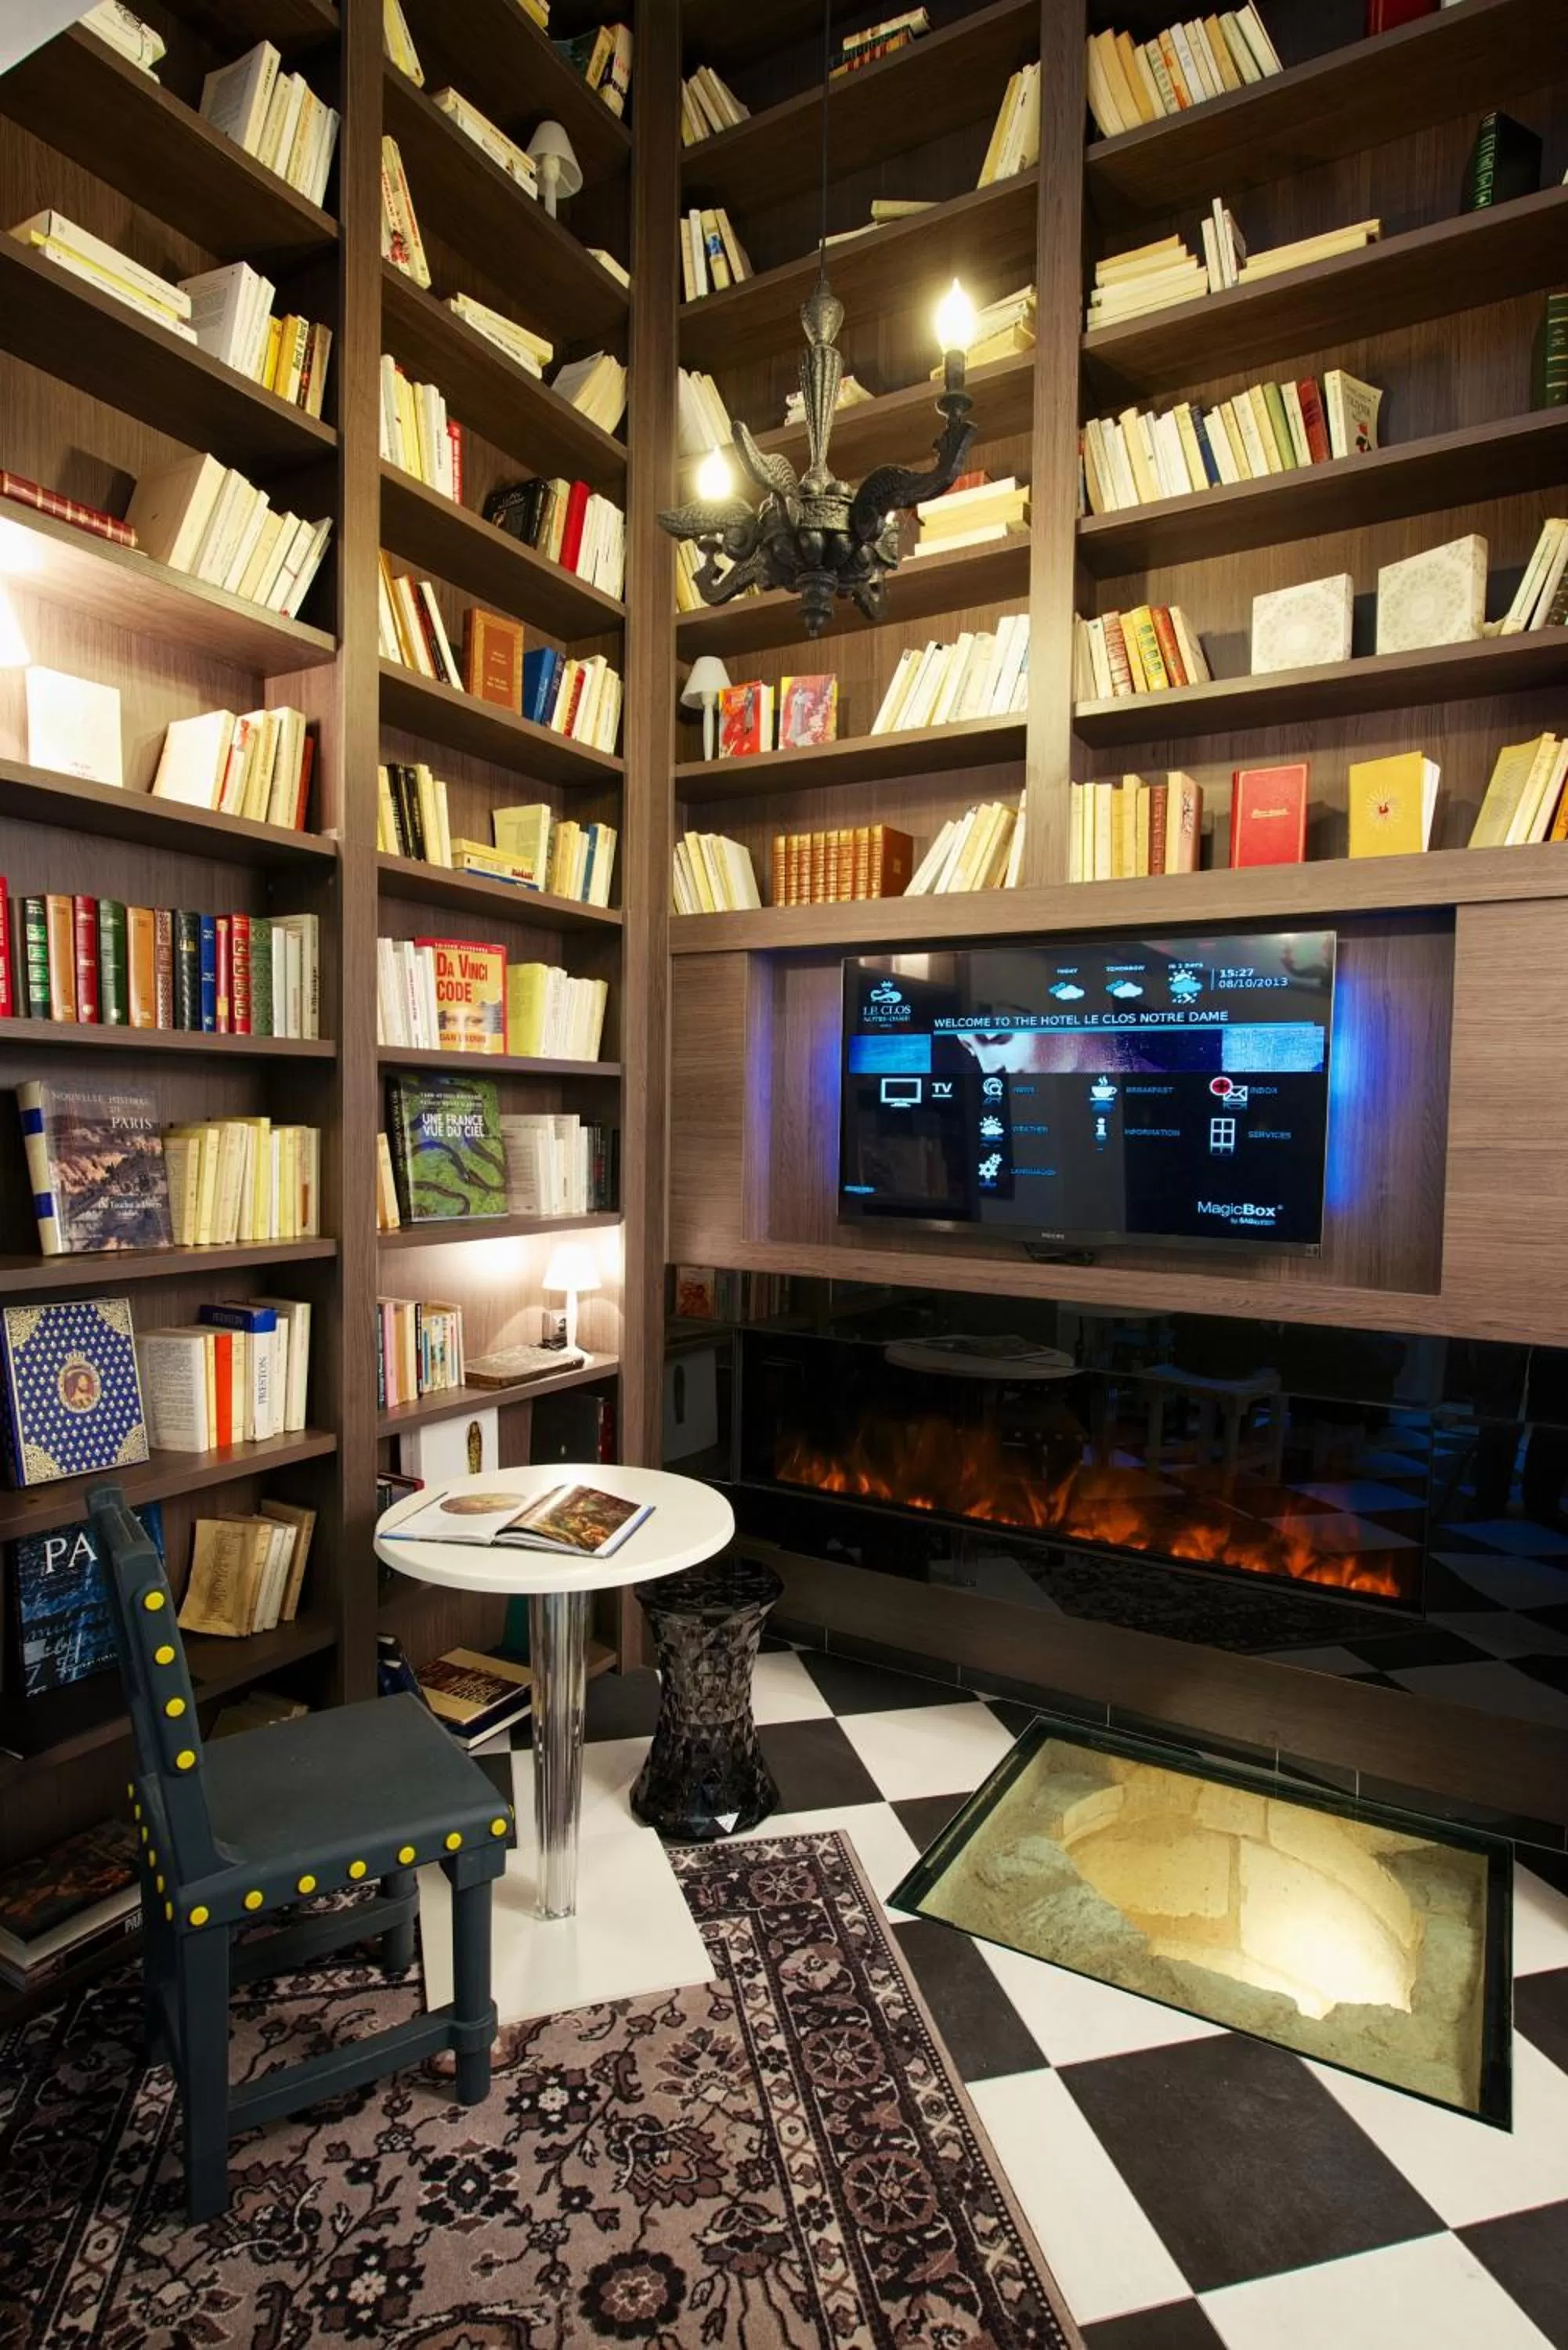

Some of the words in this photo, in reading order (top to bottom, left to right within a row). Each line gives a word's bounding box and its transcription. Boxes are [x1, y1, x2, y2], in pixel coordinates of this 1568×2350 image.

[1219, 968, 1254, 978] 15:27
[1218, 977, 1288, 989] 08/10/2013
[437, 980, 472, 1003] CODE
[934, 1018, 991, 1028] WELCOME
[995, 1017, 1010, 1027] TO
[1013, 1016, 1038, 1026] THE
[1040, 1014, 1081, 1025] HOTEL
[1084, 1014, 1099, 1025] LE
[1102, 1013, 1136, 1024] CLOS
[1140, 1011, 1185, 1023] NOTRE
[1188, 1010, 1229, 1022] DAME
[931, 1082, 952, 1094] TV
[111, 1117, 154, 1130] PARIS
[422, 1113, 443, 1124] UNE
[446, 1114, 484, 1126] FRANCE
[423, 1125, 444, 1137] VUE
[447, 1126, 462, 1137] DU
[464, 1126, 485, 1137] CIEL
